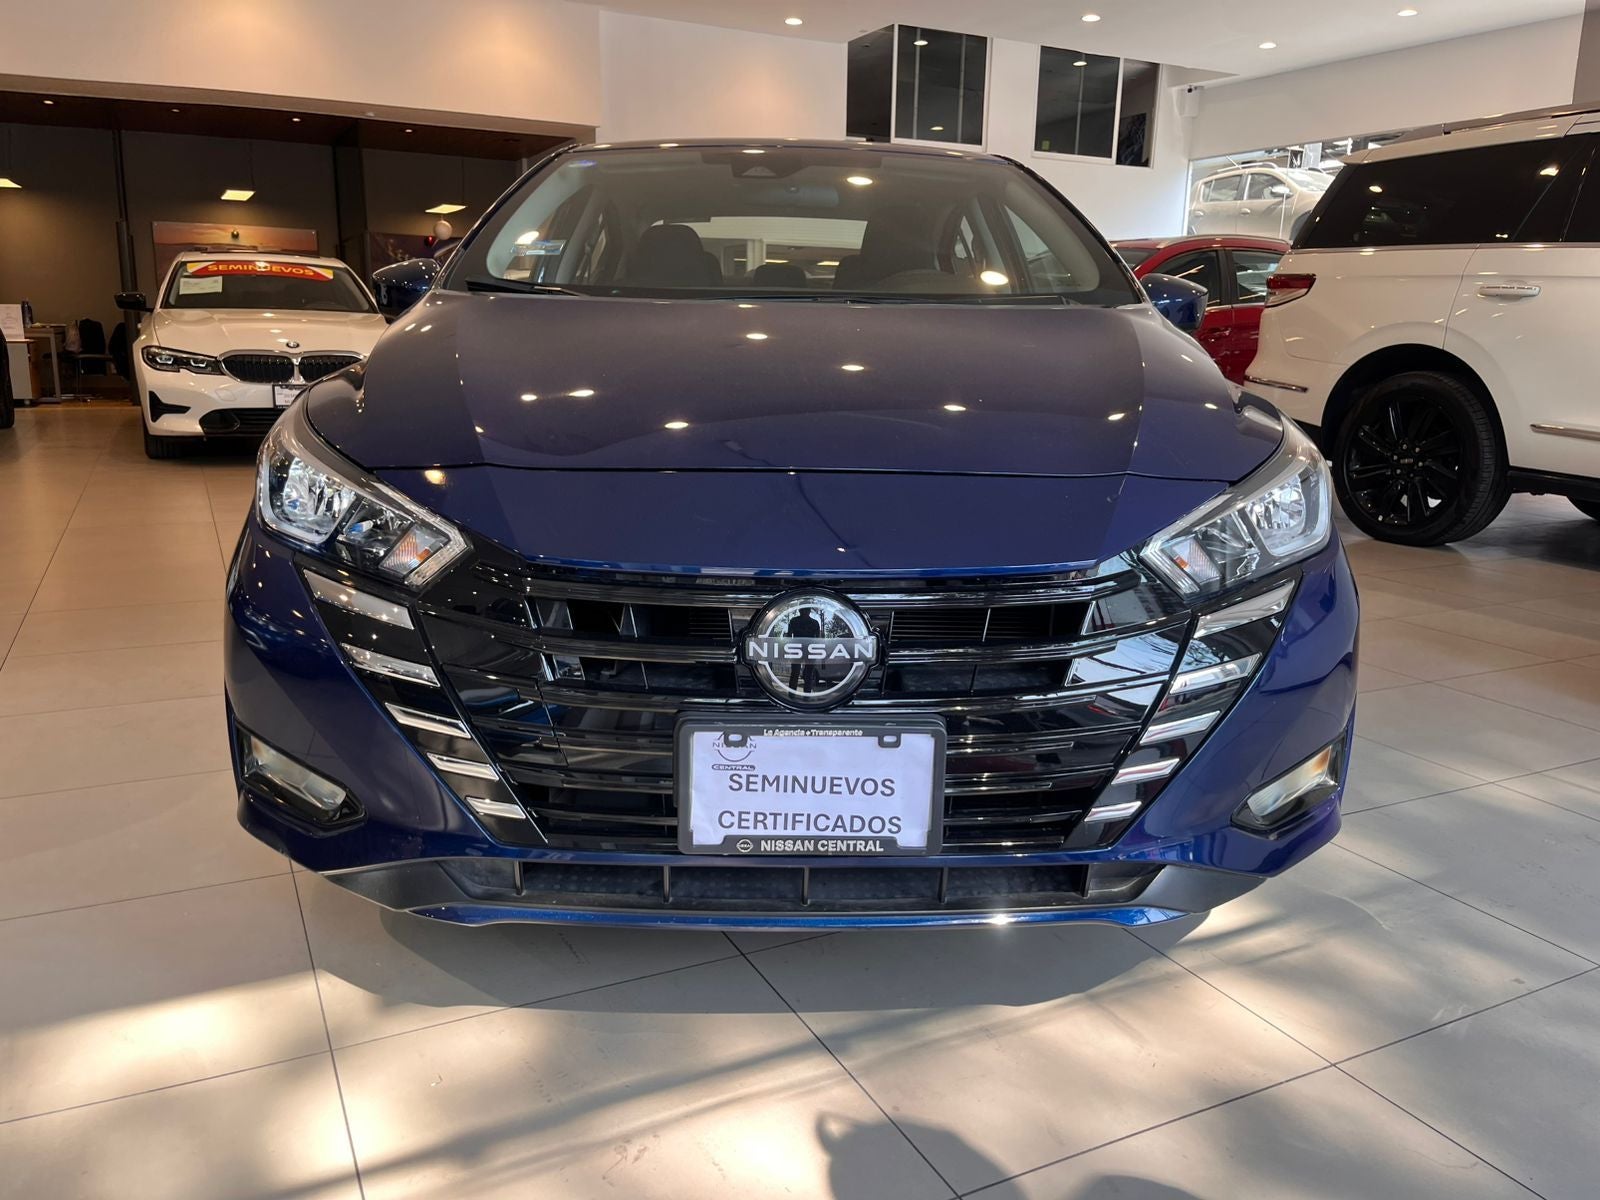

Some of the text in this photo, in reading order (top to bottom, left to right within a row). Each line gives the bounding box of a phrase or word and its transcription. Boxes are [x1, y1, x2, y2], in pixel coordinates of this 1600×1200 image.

[749, 641, 872, 659] NISSAN
[763, 729, 773, 737] La
[774, 729, 804, 737] Agencia
[728, 773, 896, 797] SEMINUEVOS
[717, 810, 902, 834] CERTIFICADOS
[760, 840, 884, 852] NISSAN CENTRAL
